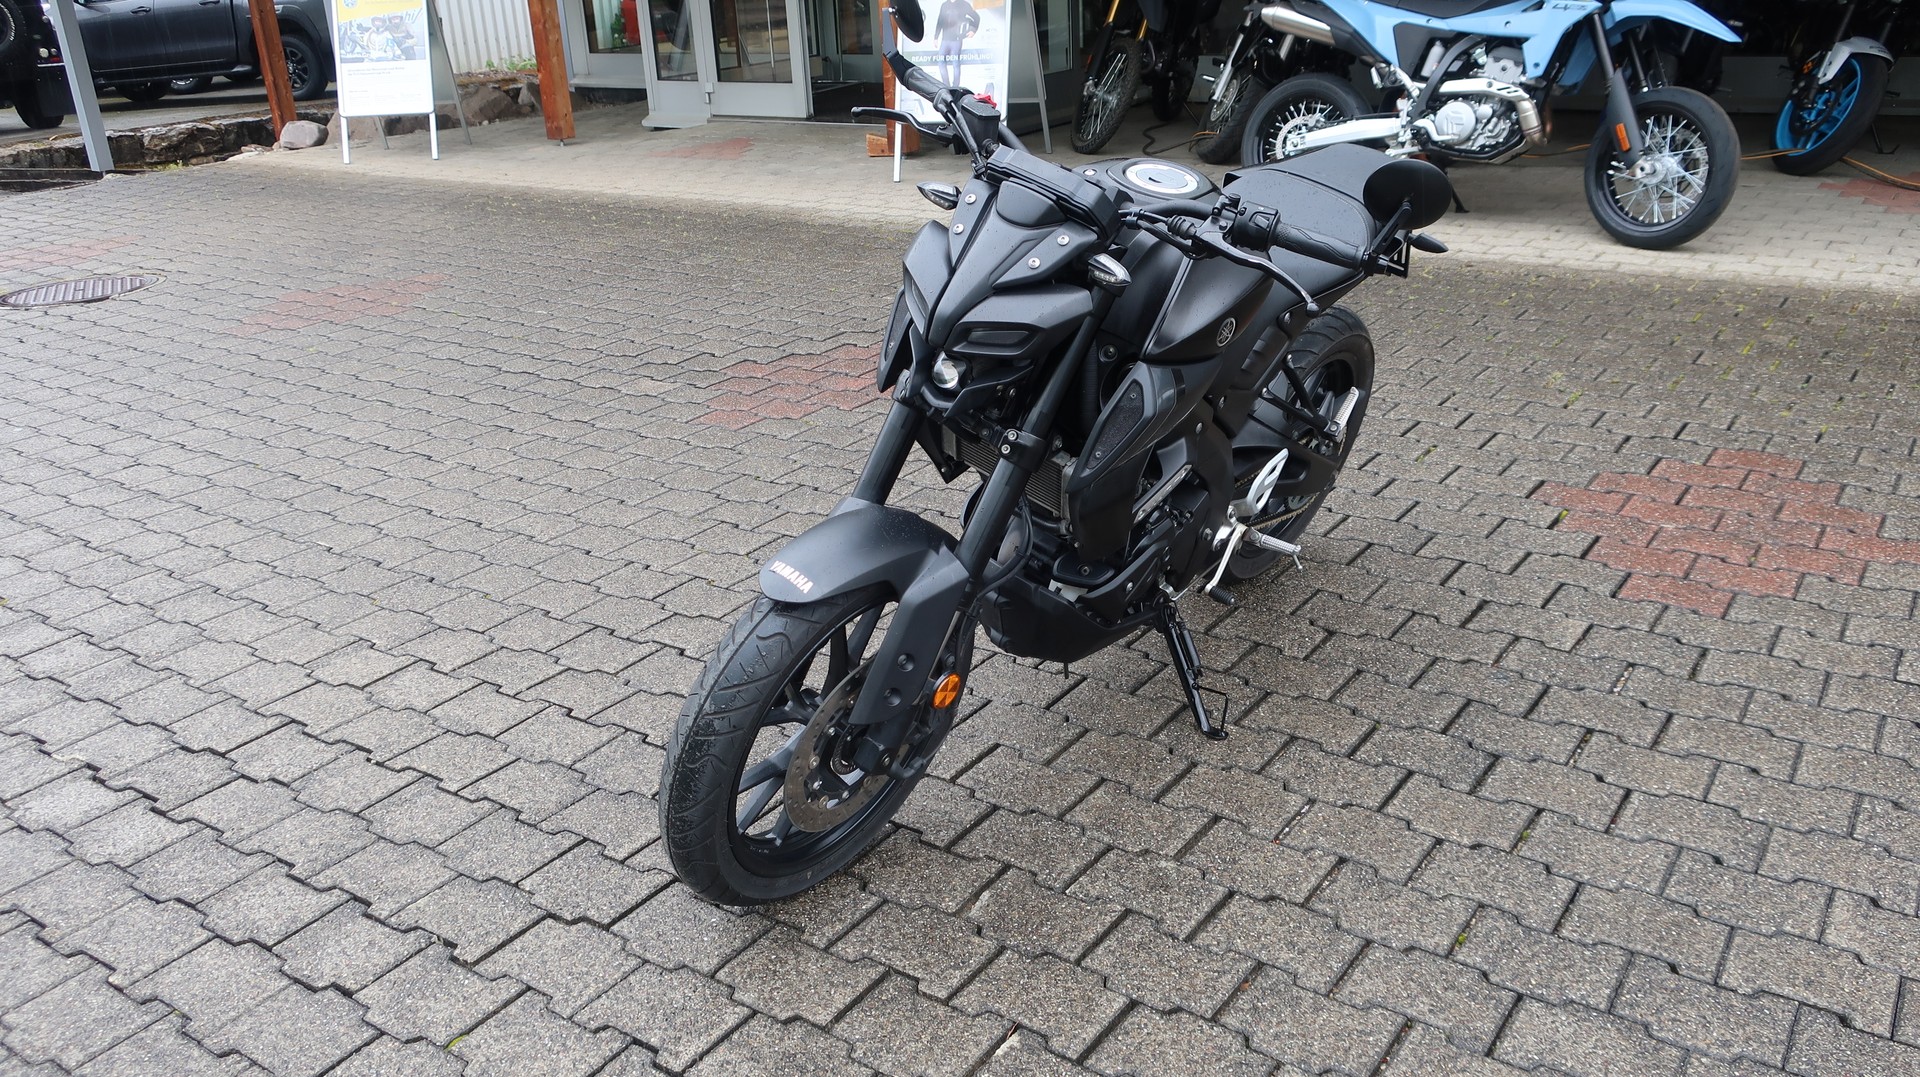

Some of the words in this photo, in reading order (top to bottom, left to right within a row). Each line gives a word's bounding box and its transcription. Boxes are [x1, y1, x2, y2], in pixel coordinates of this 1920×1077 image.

[933, 54, 945, 62] FÜR
[945, 54, 959, 62] DEN
[769, 560, 814, 594] YAMAHA
